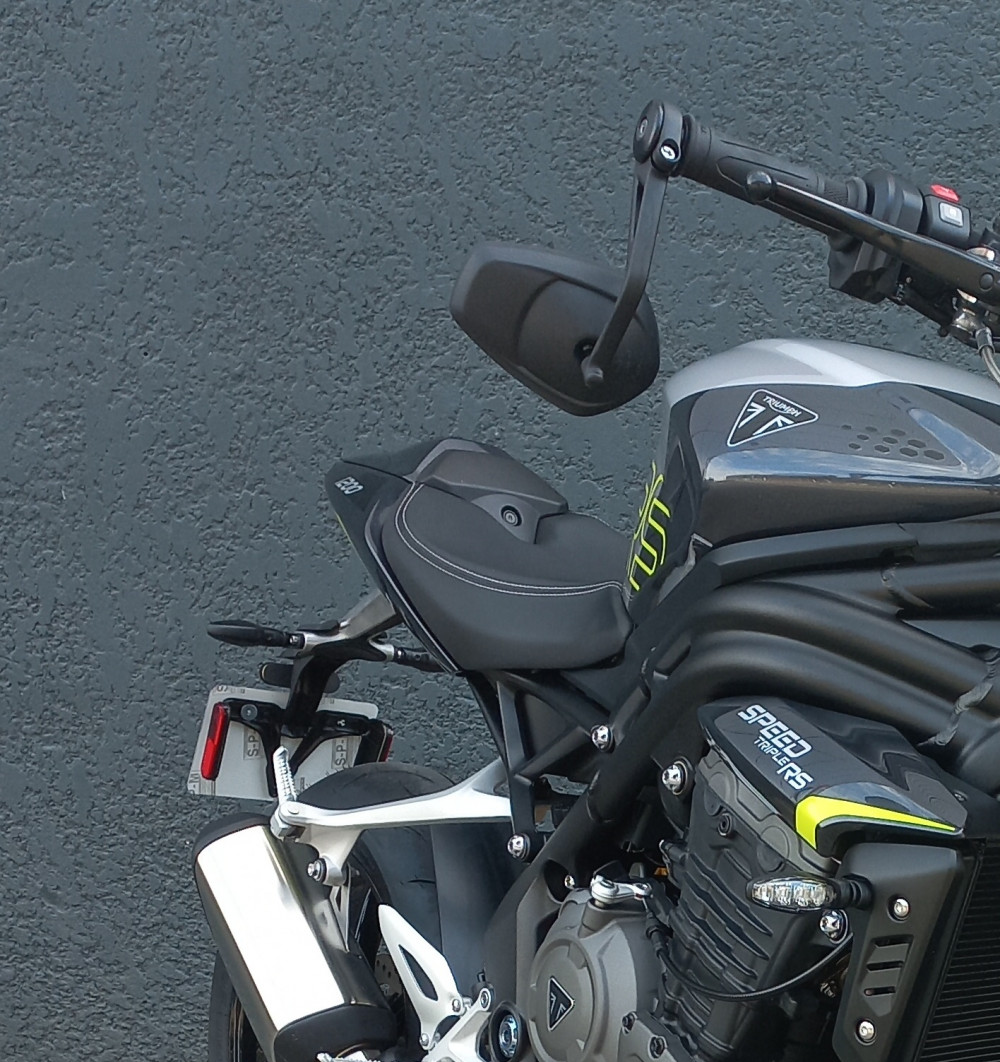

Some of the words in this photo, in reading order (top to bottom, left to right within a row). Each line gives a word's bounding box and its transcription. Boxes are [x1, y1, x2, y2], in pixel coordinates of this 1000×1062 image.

[763, 395, 801, 417] TRIUMPH
[334, 476, 363, 495] 1200
[737, 704, 812, 758] SPEED
[753, 735, 791, 767] TRIPLE
[776, 762, 814, 790] RS
